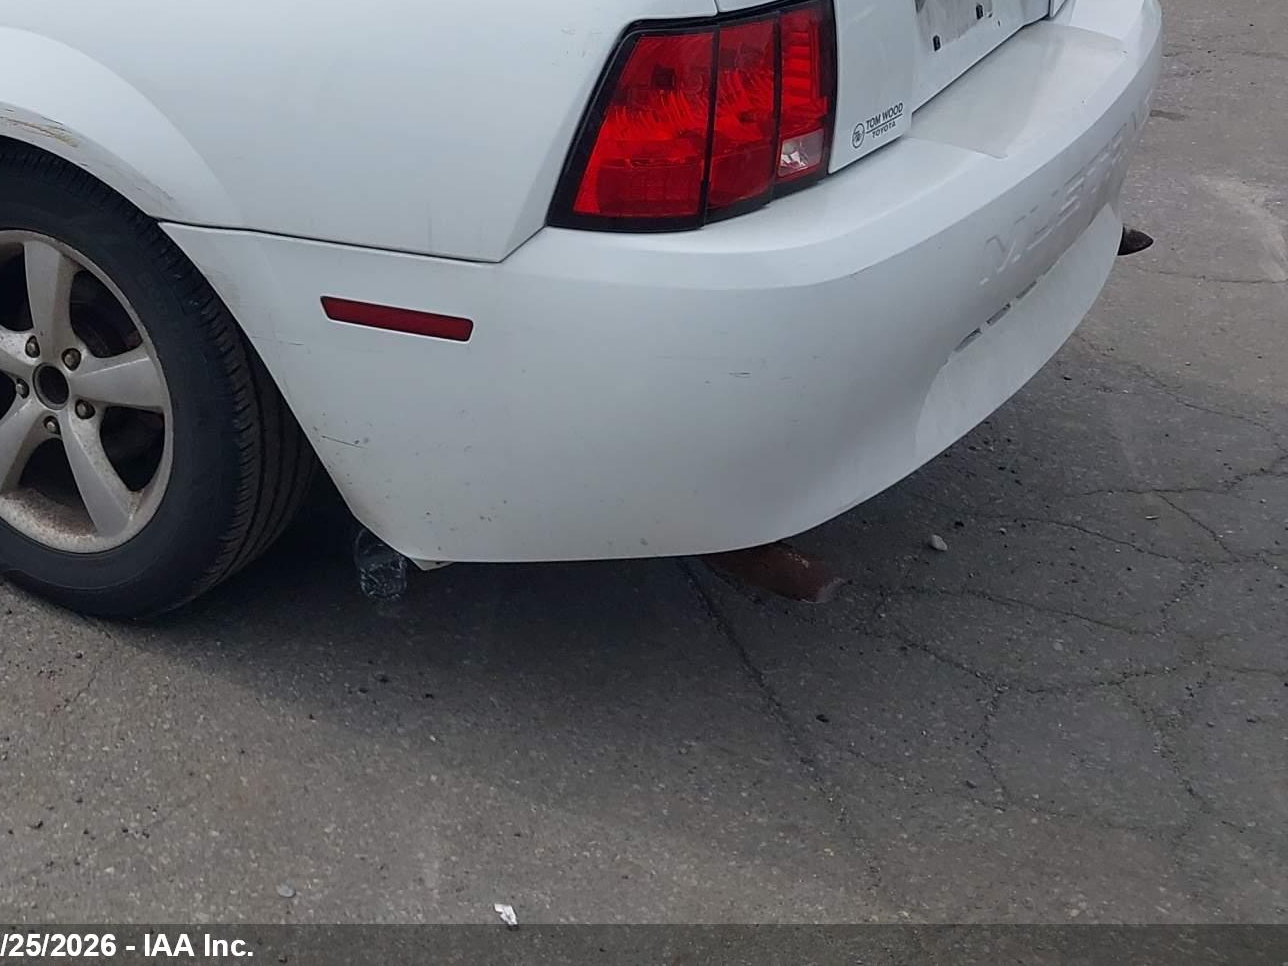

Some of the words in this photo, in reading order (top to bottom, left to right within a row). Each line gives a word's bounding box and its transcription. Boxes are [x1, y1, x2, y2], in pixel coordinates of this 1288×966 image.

[866, 113, 882, 130] TOM
[881, 102, 903, 122] WOOD
[872, 120, 896, 138] TOYOTA
